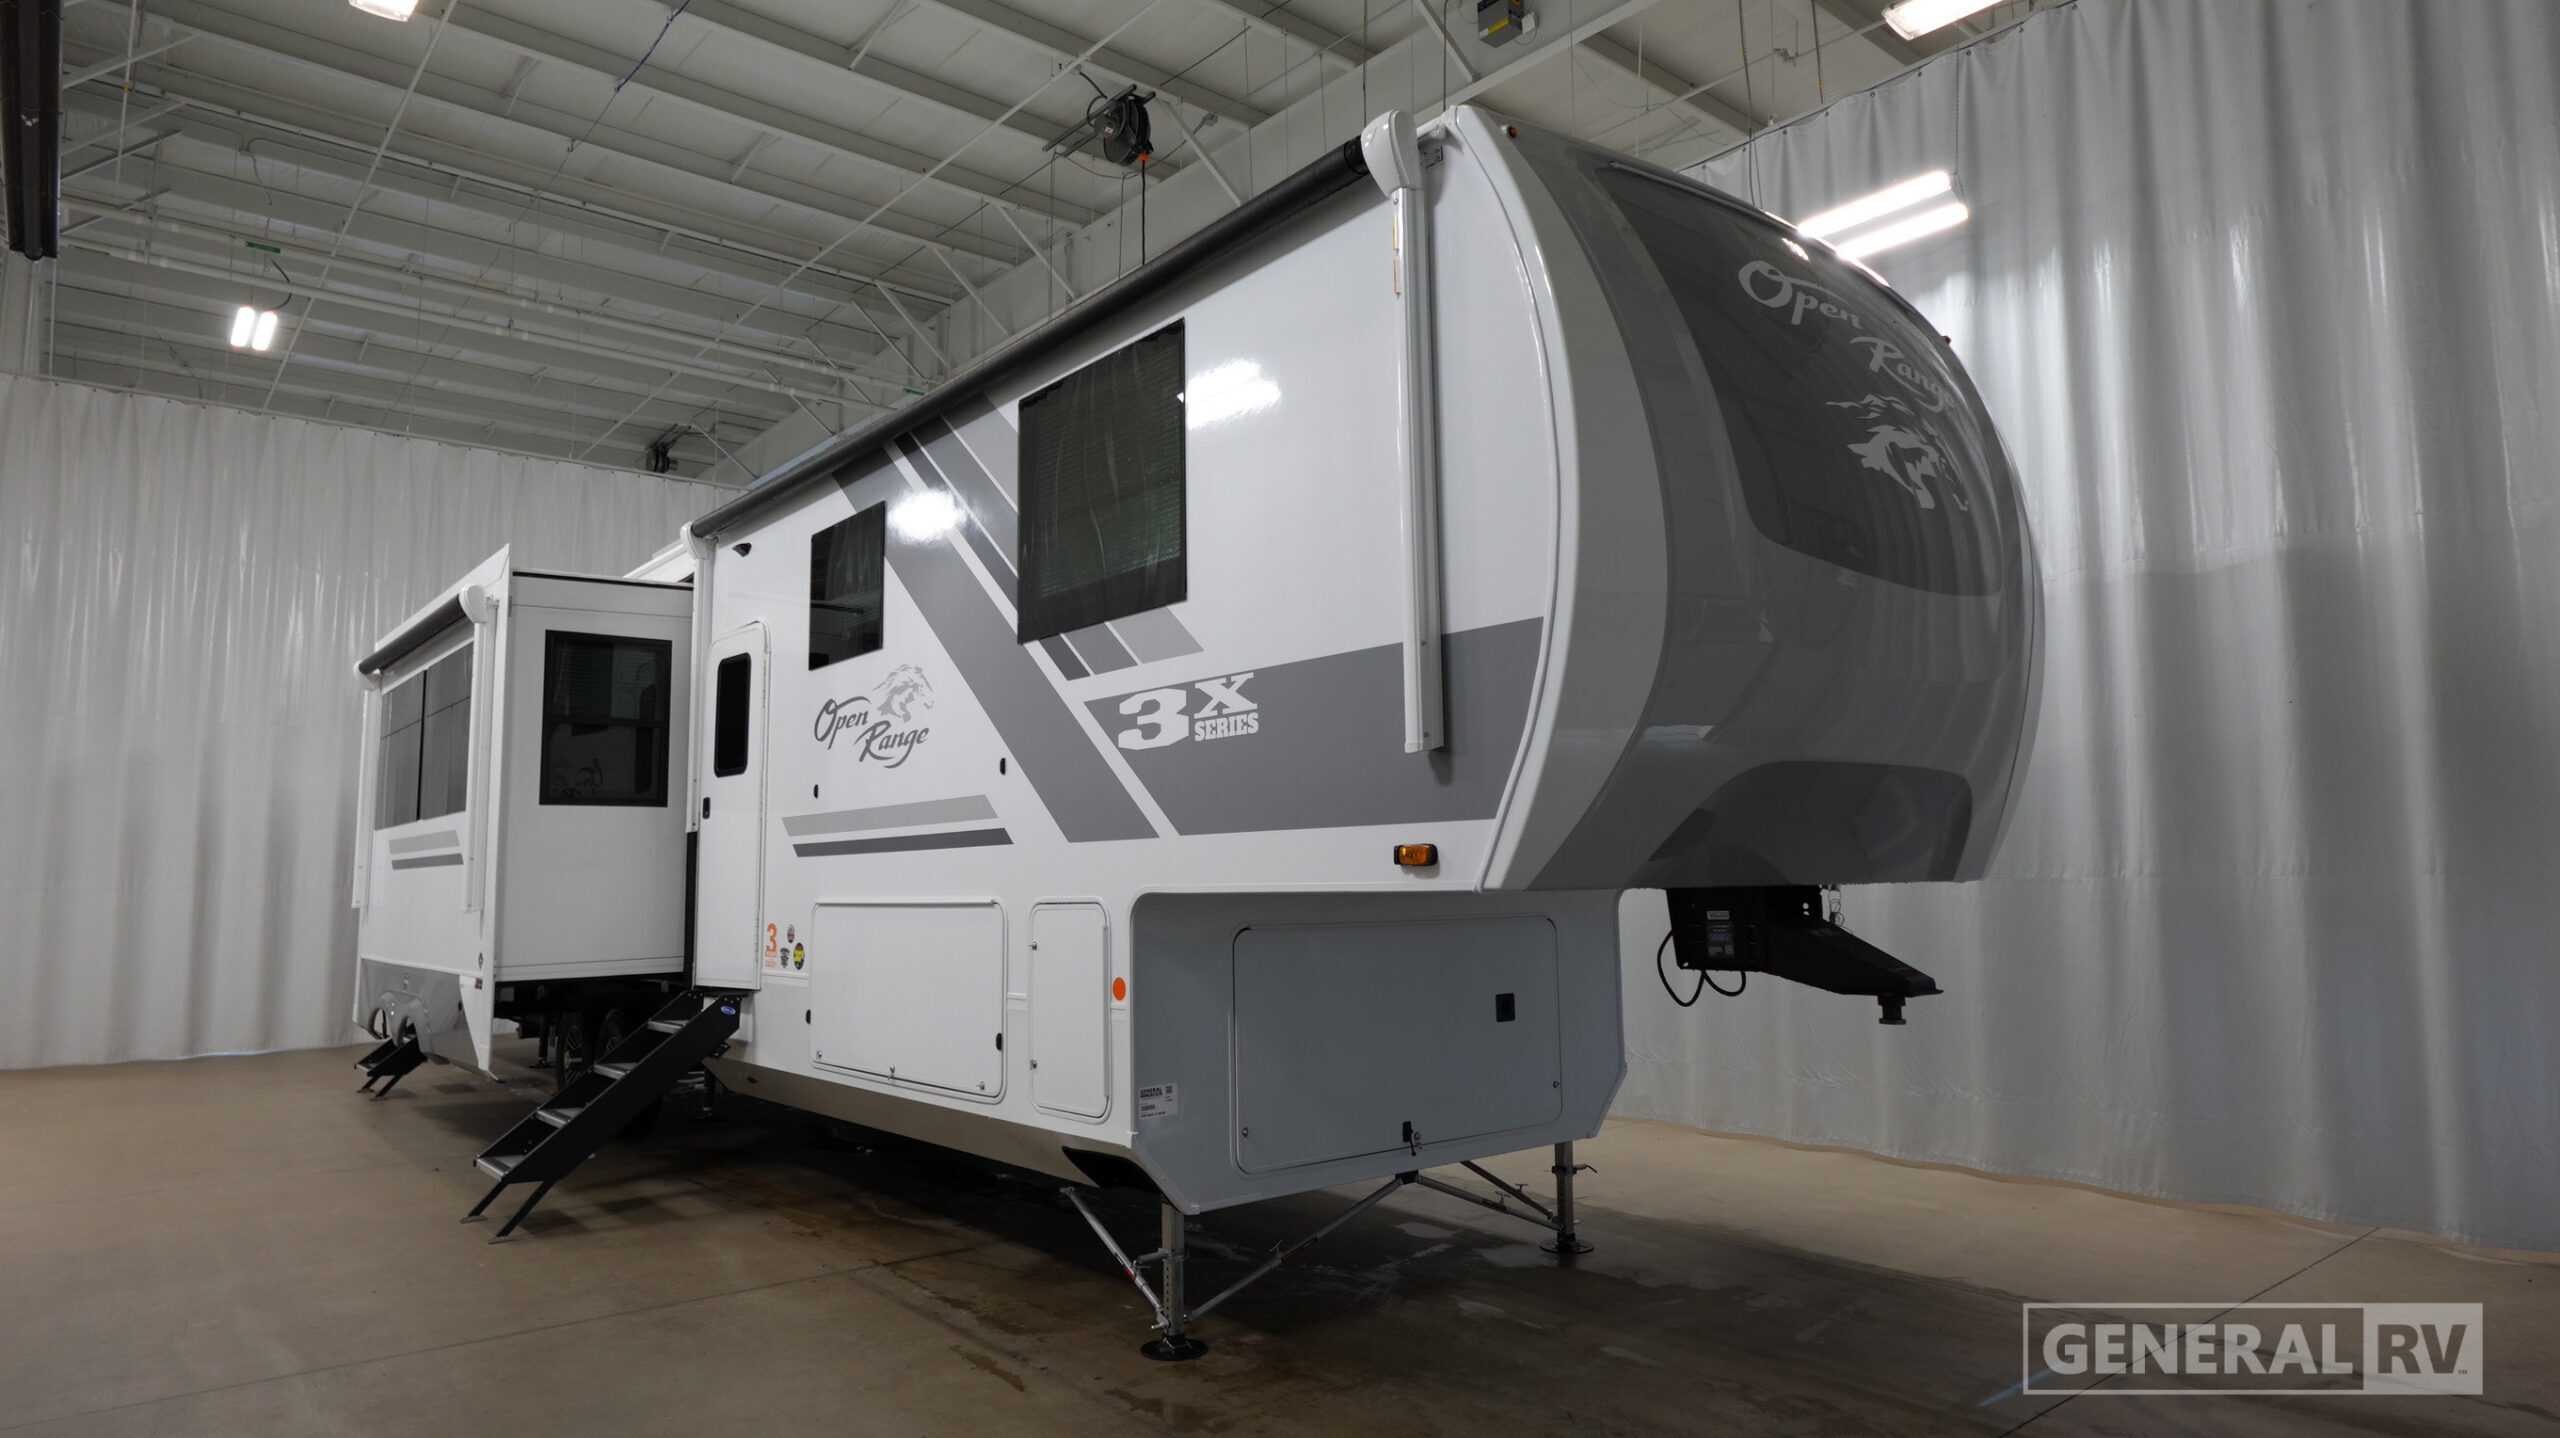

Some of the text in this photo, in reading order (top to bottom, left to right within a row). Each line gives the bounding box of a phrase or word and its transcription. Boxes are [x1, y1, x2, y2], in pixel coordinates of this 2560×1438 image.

[1738, 260, 1863, 330] Open
[1850, 336, 1955, 413] Range
[814, 696, 872, 751] Open
[1118, 672, 1258, 750] 3 X
[1194, 712, 1260, 742] SERIES
[853, 720, 930, 769] Range
[765, 923, 777, 952] 3
